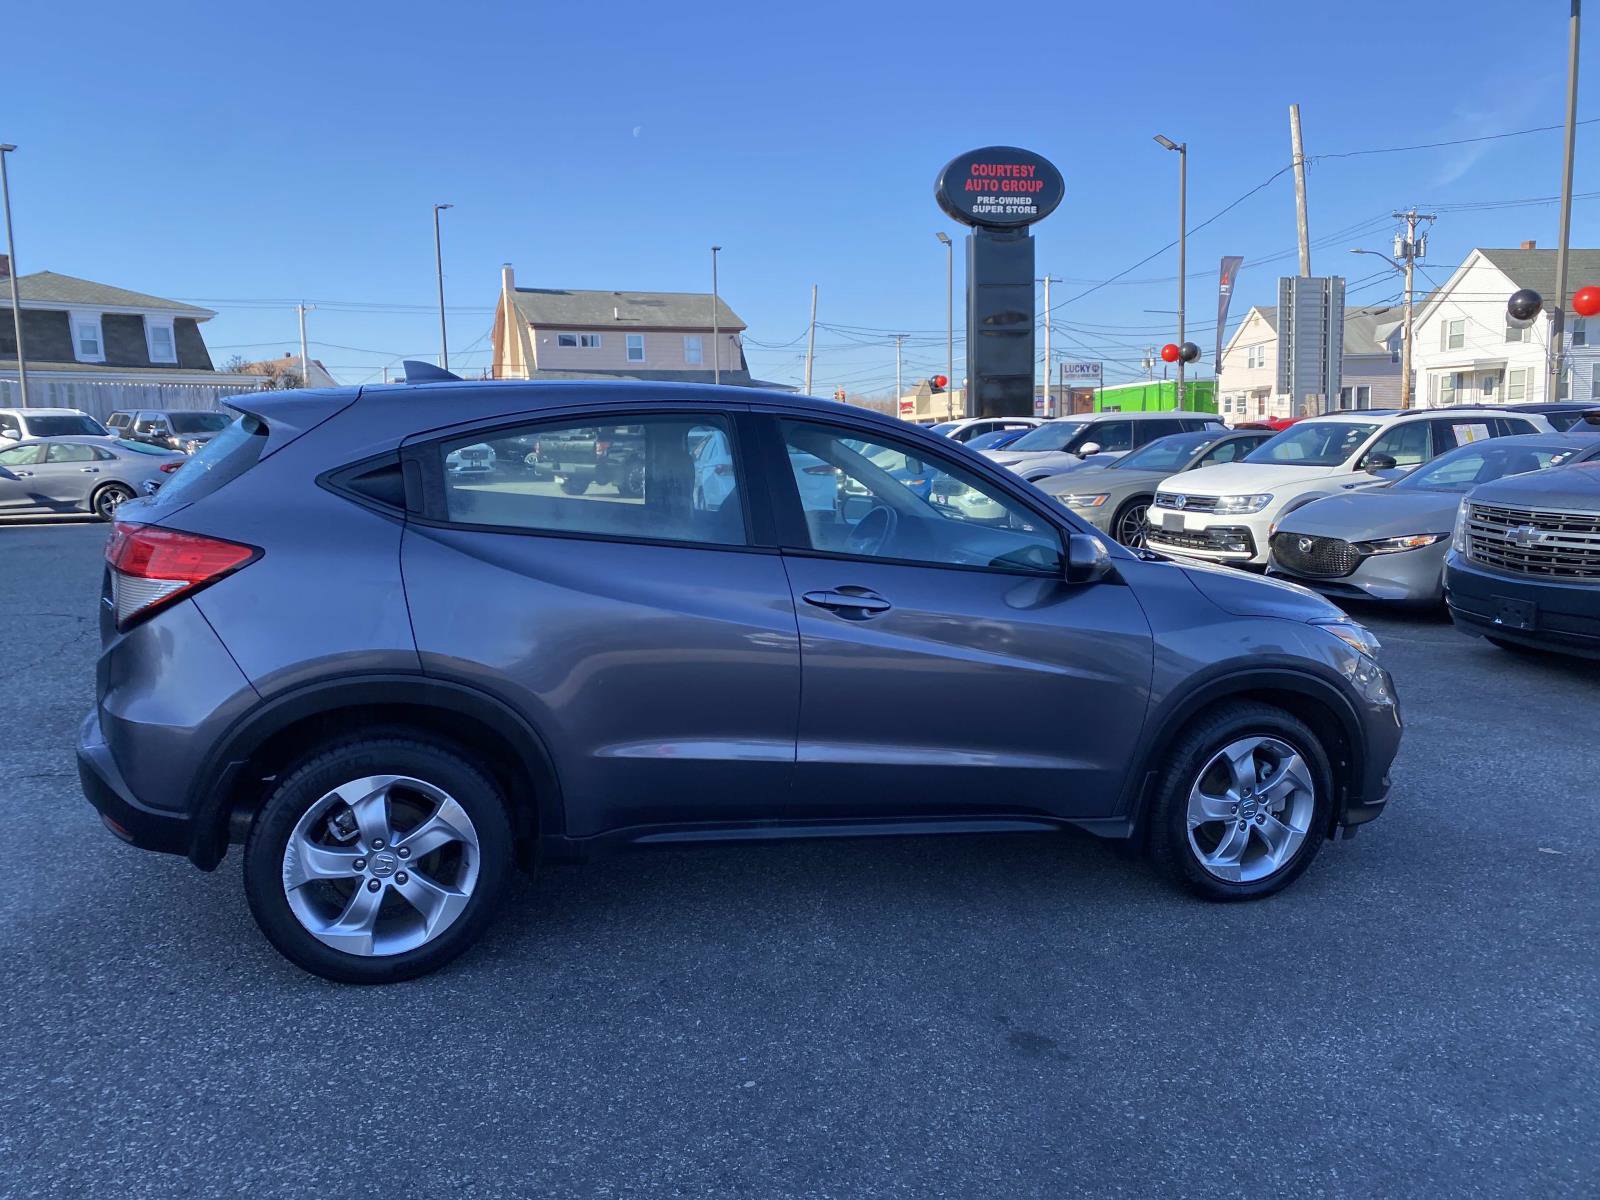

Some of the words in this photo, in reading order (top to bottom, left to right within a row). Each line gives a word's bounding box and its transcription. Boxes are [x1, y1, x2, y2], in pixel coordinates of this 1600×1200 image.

[971, 163, 1035, 177] COURTESY
[965, 178, 999, 192] AUTO
[1001, 179, 1044, 192] GROUP
[977, 196, 1032, 205] PRE-OWNED
[972, 205, 1004, 213] SUPER
[1005, 205, 1037, 214] STORE
[1064, 364, 1090, 373] LUCKY
